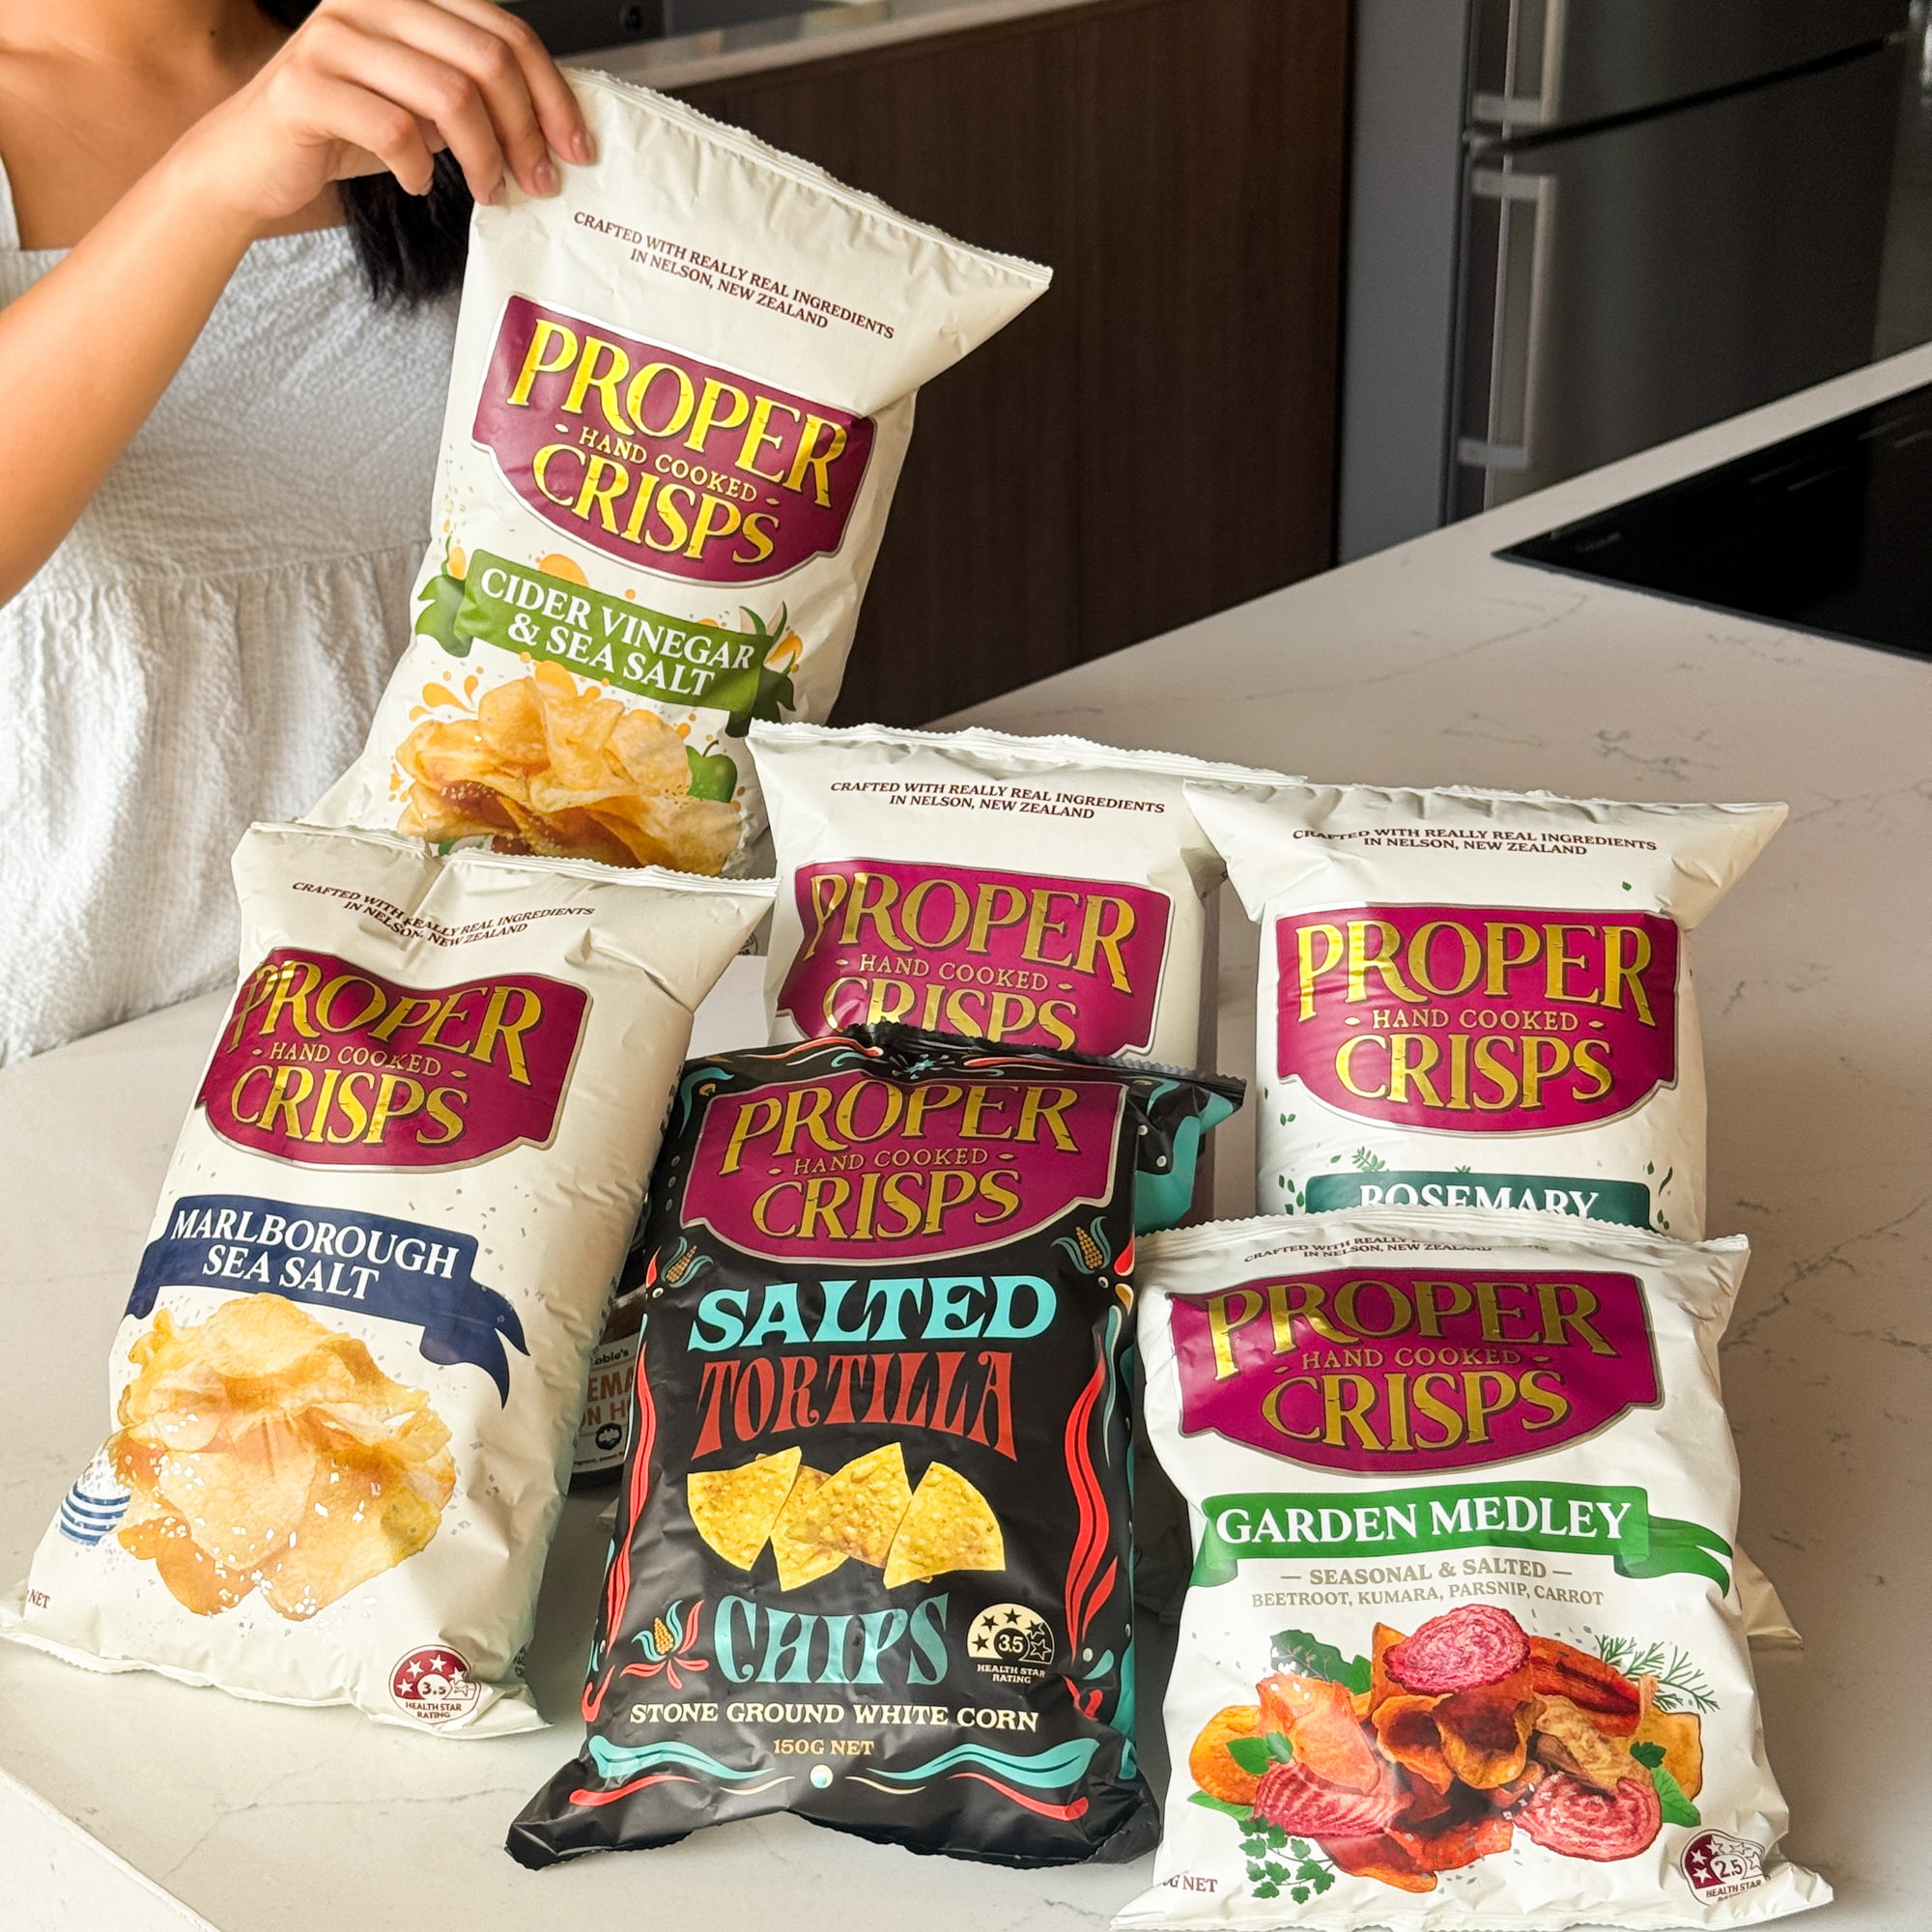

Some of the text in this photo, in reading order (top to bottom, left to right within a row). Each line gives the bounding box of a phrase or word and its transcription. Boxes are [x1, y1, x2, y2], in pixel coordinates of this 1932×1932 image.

[574, 212, 895, 339] CRAFTED WITH REALLY REAL INGREDIENTS
[630, 248, 829, 329] IN NELSON, NEW ZEALAND
[506, 319, 847, 508] PROPER
[580, 427, 757, 503] HAND COOKED
[533, 443, 780, 564] CRISPS
[480, 568, 754, 669] CIDER VINEGAR
[507, 613, 714, 696] & SEA SALT
[830, 782, 1165, 813] CRAFTED WITH REALLY REAL INGREDIENTS
[889, 795, 1094, 819] IN NELSON, NEW ZEALAND
[1293, 829, 1657, 851] CRAFTED WITH REALLY REAL INGREDIENTS
[1363, 838, 1587, 855] IN NELSON, NEW ZEALAND
[293, 882, 361, 900] CRAFTED
[364, 895, 404, 919] WITH
[460, 919, 494, 935] REAL
[496, 908, 595, 925] INGREDIENTS
[343, 900, 361, 910] IN
[428, 932, 465, 948] NEW
[465, 923, 527, 943] ZEALAND
[804, 872, 1134, 994] PROPER
[859, 954, 1048, 991] HAND COOKED
[1295, 920, 1657, 1027] PROPER
[227, 959, 543, 1085] PROPER
[822, 976, 1077, 1051] CRISPS
[1372, 1008, 1578, 1033] HAND COOKED
[270, 1042, 442, 1076] HAND COOKED
[1334, 1033, 1610, 1110] CRISPS
[230, 1065, 468, 1146] CRISPS
[719, 1079, 1080, 1177] PROPER
[793, 1148, 988, 1176] HAND COOKED
[753, 1170, 1019, 1240] CRISPS
[171, 1209, 459, 1278] MARLBOROUGH
[1244, 1244, 1308, 1263] CRAFTED
[1311, 1240, 1350, 1253] WITH
[1354, 1236, 1406, 1245] REALLY
[1322, 1244, 1384, 1258] NELSON,
[203, 1244, 379, 1301] SEA SALT
[687, 1275, 1058, 1351] SALTED
[1205, 1279, 1616, 1382] PROPER
[592, 1350, 630, 1365] oble's
[1301, 1347, 1520, 1372] HAND COOKED
[692, 1352, 1017, 1461] TORTILLA
[1261, 1369, 1567, 1453] CRISPS
[1216, 1496, 1632, 1545] GARDEN MEDLEY
[1309, 1558, 1547, 1585] SEASONAL & SALTED
[28, 1589, 50, 1608] NET
[1251, 1580, 1604, 1609] BEETROOT, KUMARA, PARSNIP, CARROT
[713, 1593, 949, 1686] CHIPS
[999, 1634, 1024, 1654] 3.5
[422, 1682, 446, 1695] 3.5
[978, 1664, 1045, 1677] HEALTH STAR
[992, 1674, 1031, 1683] RATING
[406, 1702, 439, 1711] HEALTH
[630, 1703, 1039, 1732] STONE GROUND WHITE CORN
[773, 1740, 874, 1755] 150G NET
[1182, 1875, 1217, 1892] NET
[1706, 1884, 1738, 1898] HEALTH
[1739, 1879, 1762, 1891] STAR
[1715, 1860, 1743, 1878] 2.5
